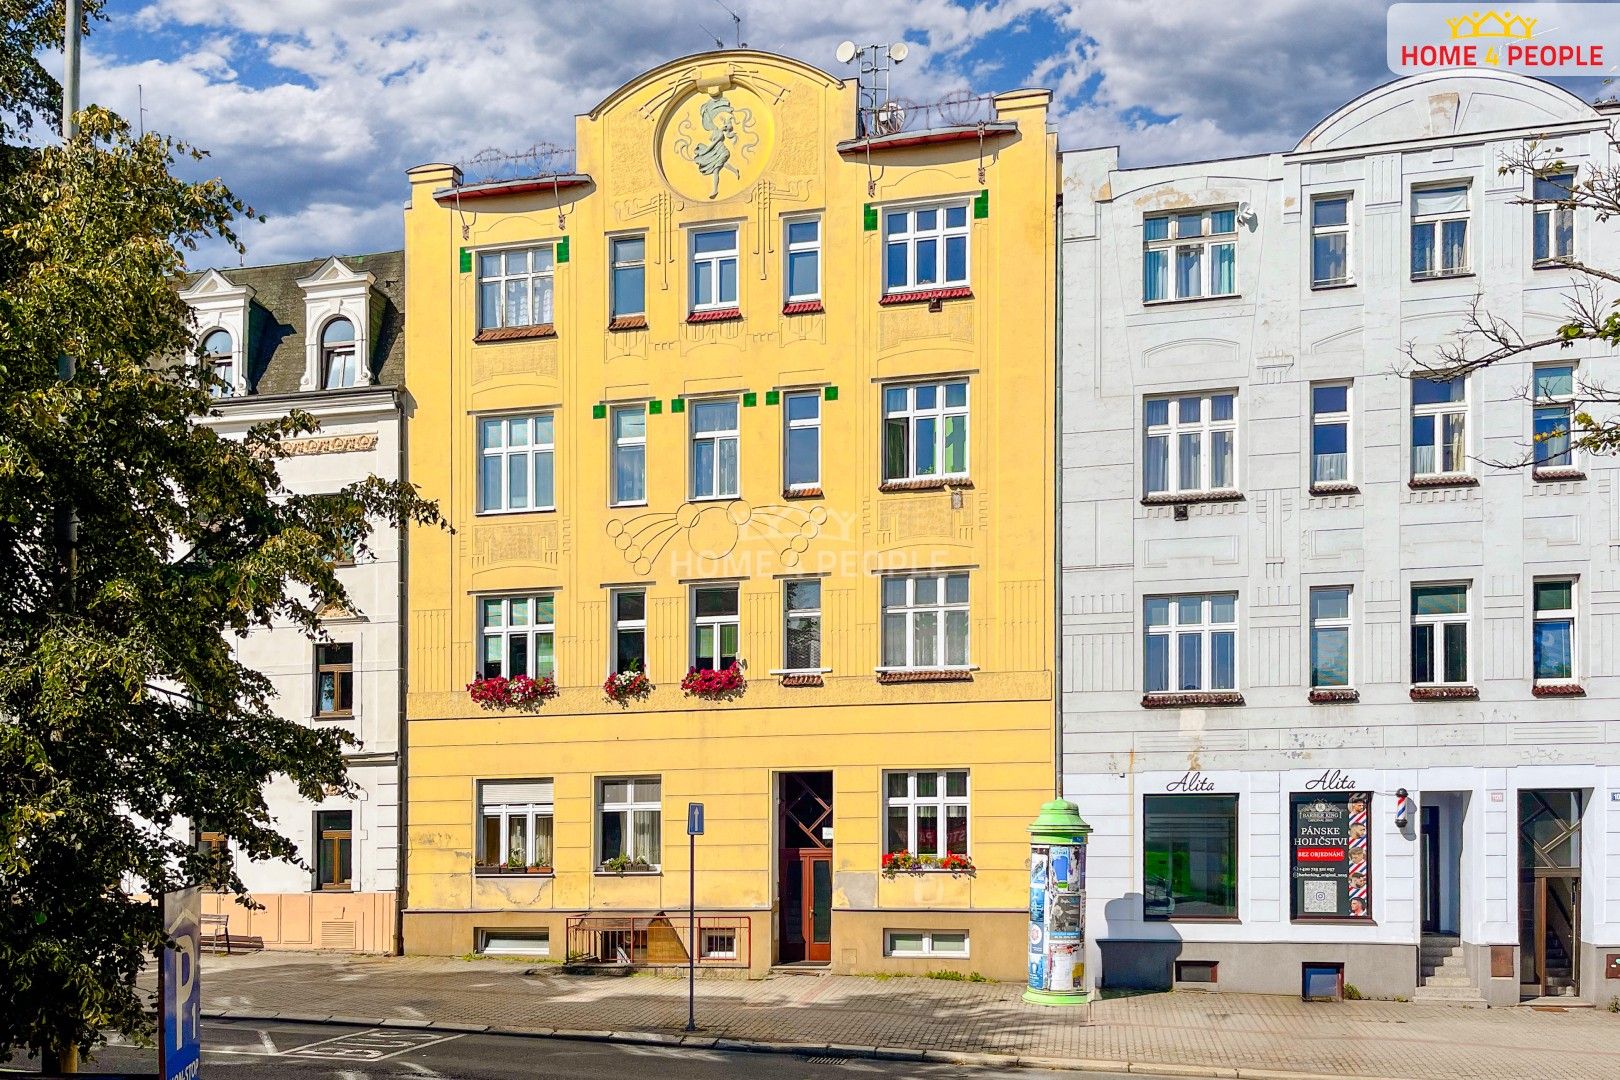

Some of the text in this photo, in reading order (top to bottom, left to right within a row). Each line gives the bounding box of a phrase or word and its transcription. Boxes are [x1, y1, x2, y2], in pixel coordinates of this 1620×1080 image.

[1166, 771, 1215, 792] Alita
[1305, 769, 1356, 790] Alita
[1301, 826, 1340, 835] PÁNSKE
[1310, 850, 1344, 858] OBJEDNÁNÍ
[297, 1031, 443, 1058] BUS
